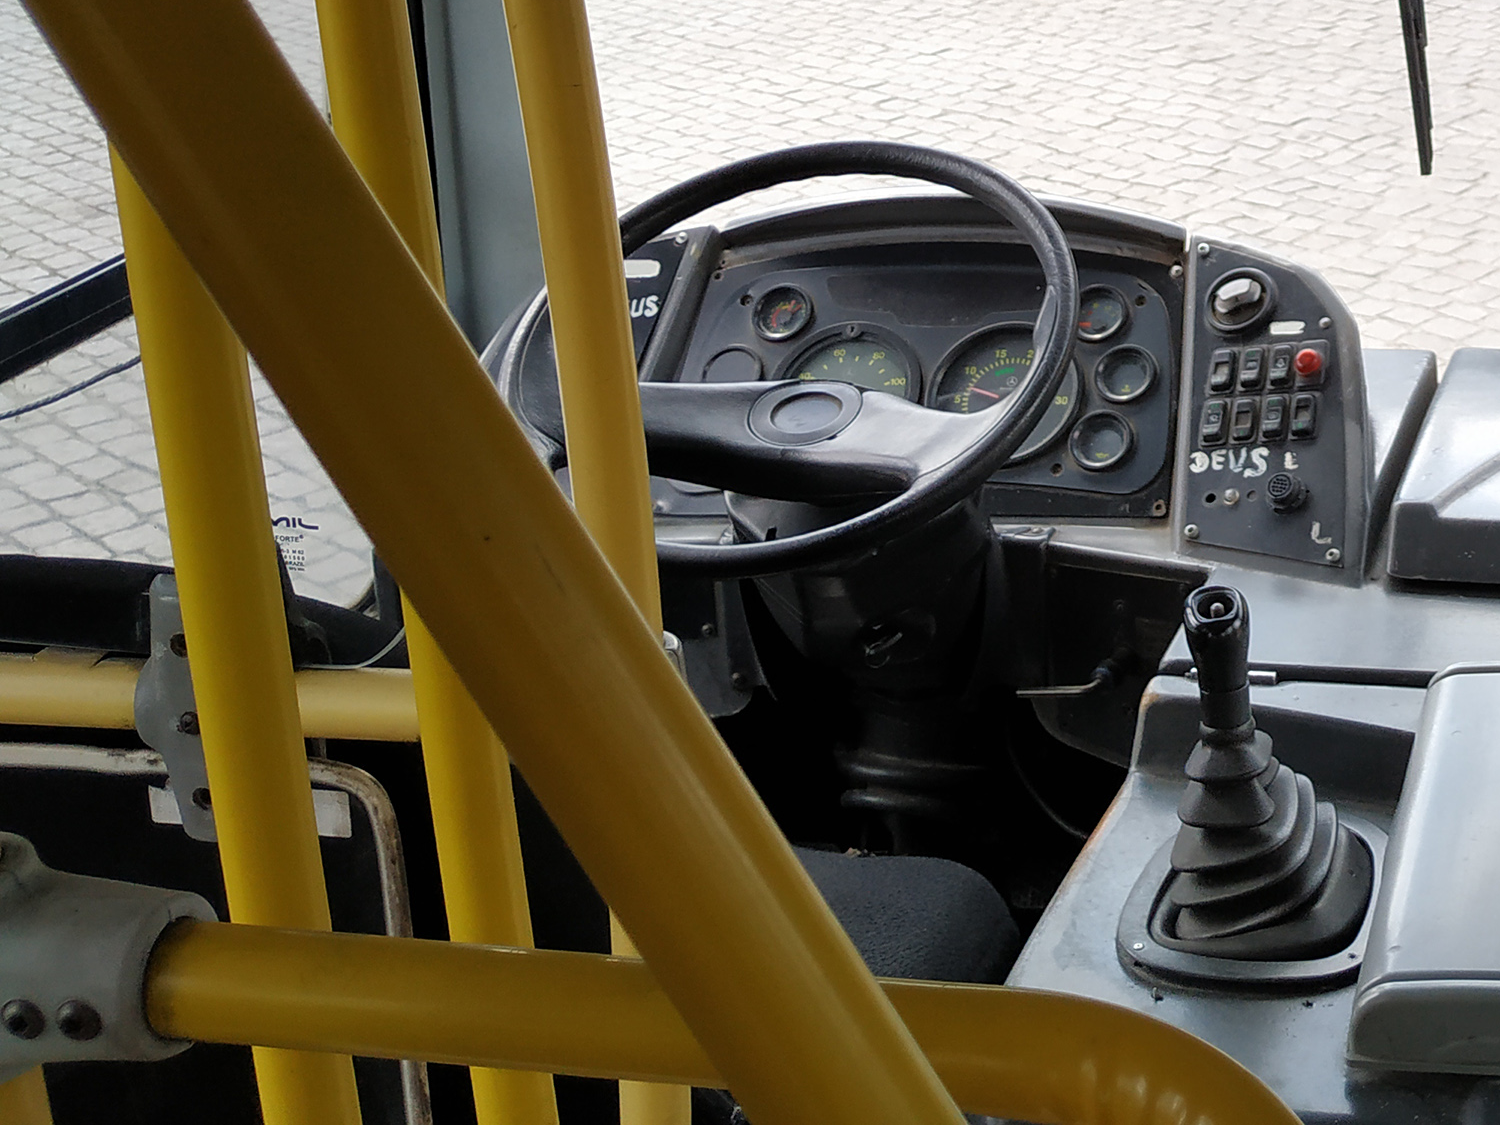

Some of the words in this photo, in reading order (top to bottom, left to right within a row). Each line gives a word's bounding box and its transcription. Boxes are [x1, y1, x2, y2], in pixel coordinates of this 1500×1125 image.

[630, 294, 659, 318] US
[995, 349, 1008, 358] 15
[1026, 349, 1035, 358] 2
[965, 366, 977, 375] 10
[1055, 395, 1068, 405] 30
[1189, 446, 1270, 478] DEUS
